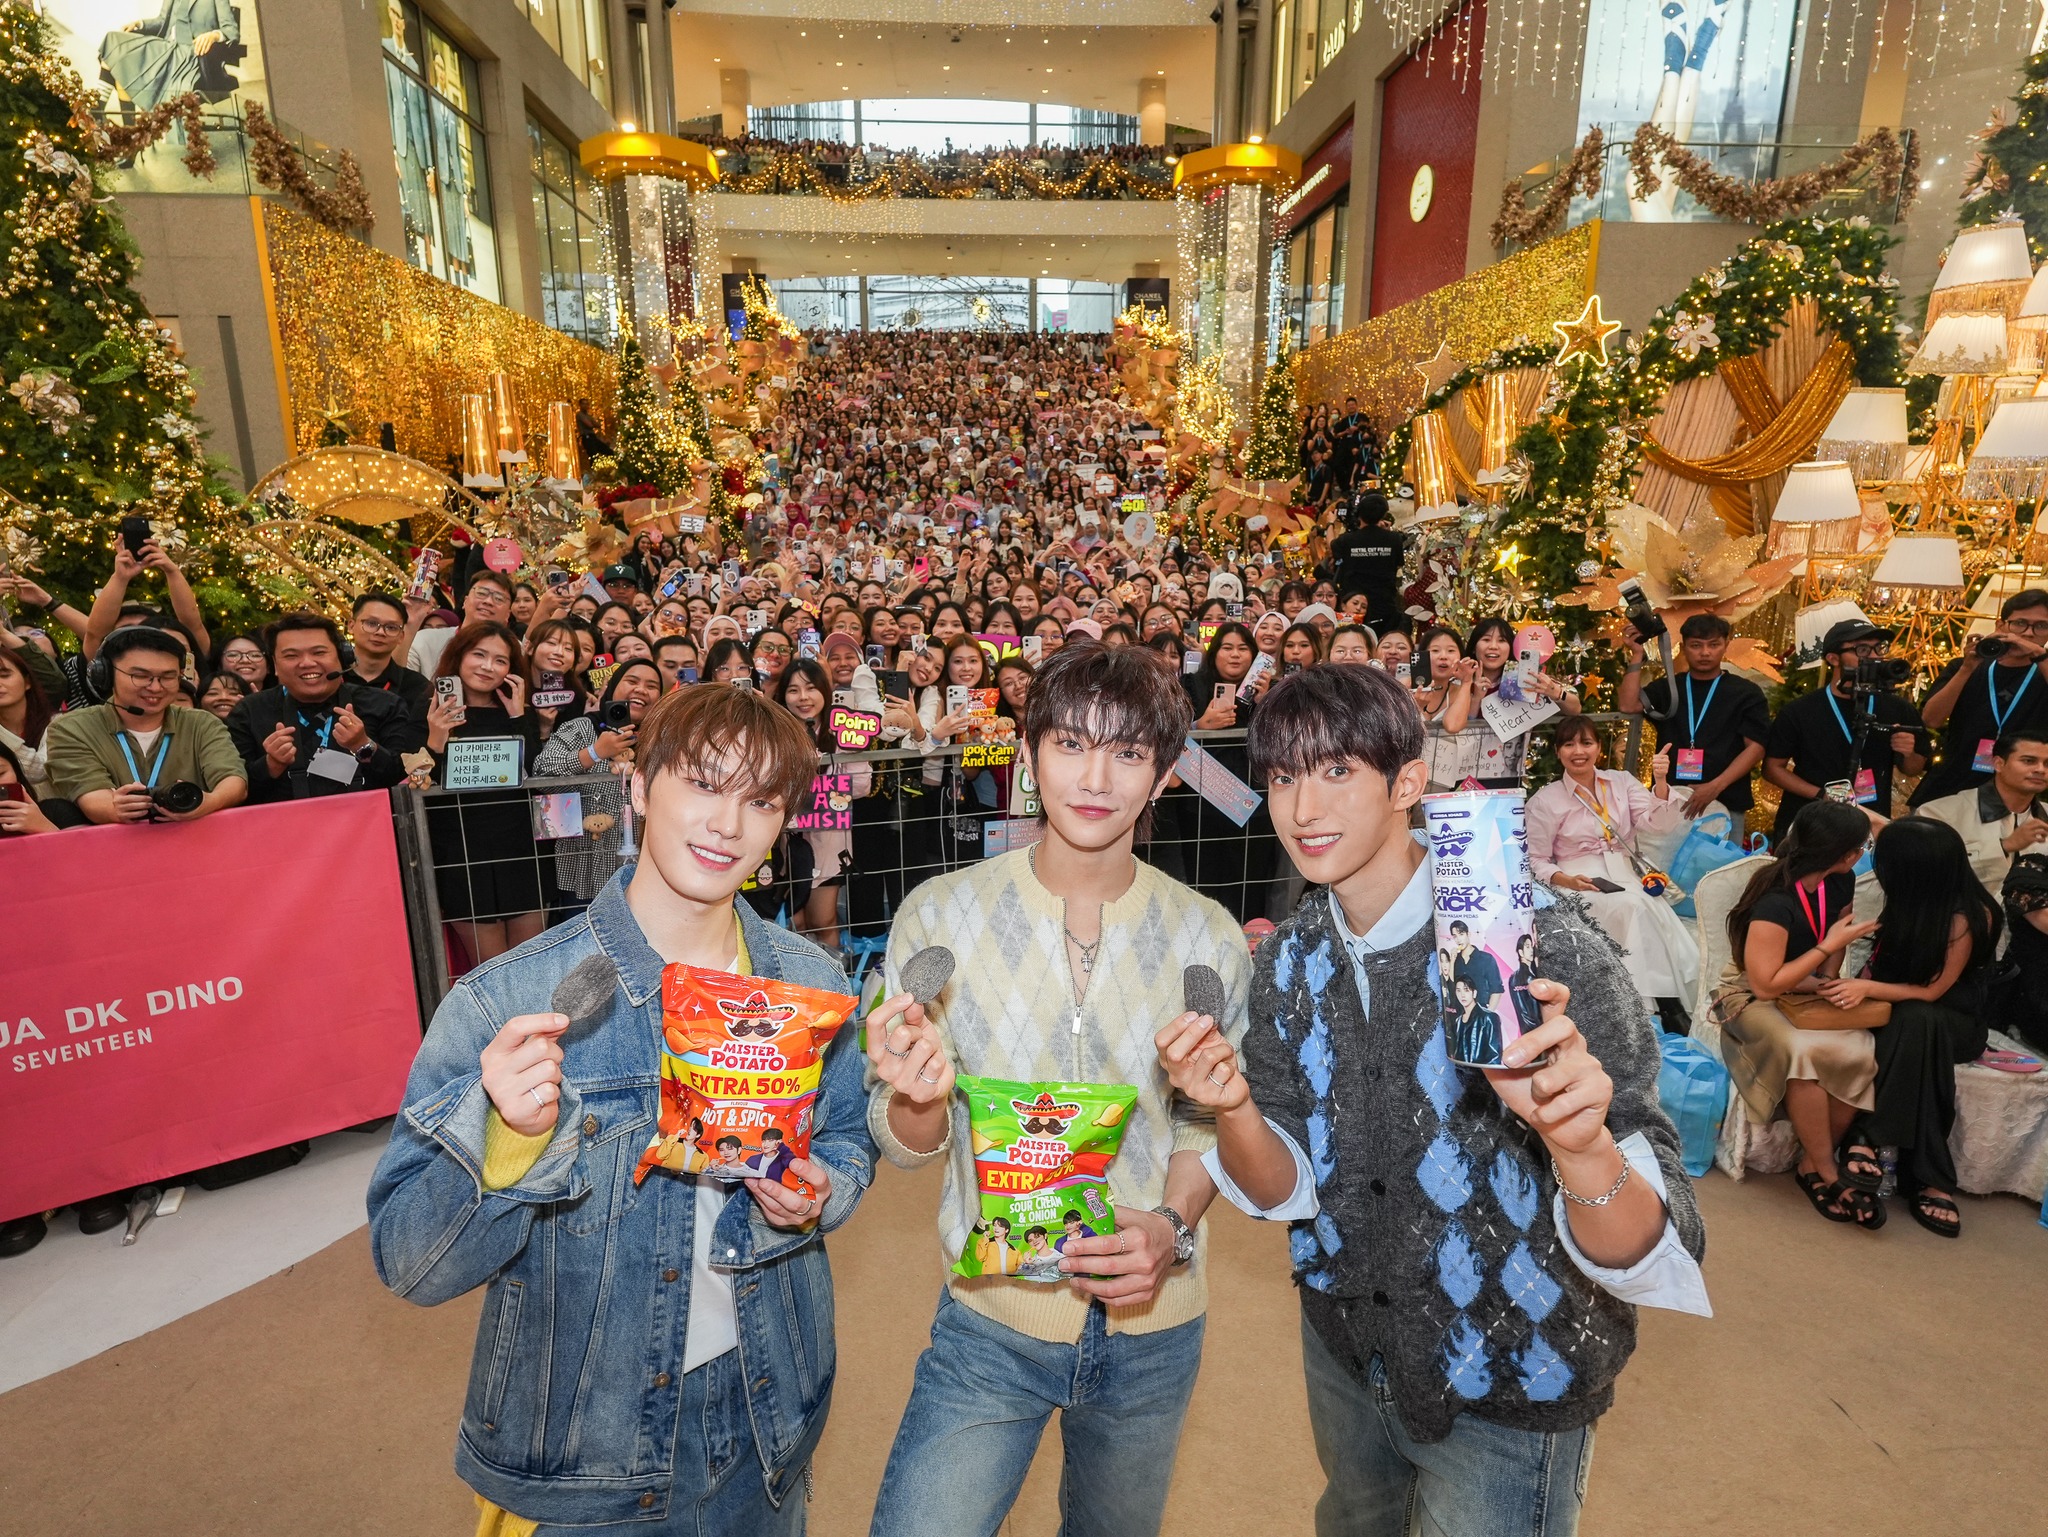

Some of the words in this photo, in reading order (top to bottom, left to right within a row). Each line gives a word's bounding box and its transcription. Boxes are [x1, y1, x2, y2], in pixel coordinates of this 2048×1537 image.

[801, 599, 821, 619] DK
[834, 712, 877, 732] Point
[1499, 707, 1532, 733] Heart
[841, 730, 866, 746] Me
[454, 744, 463, 753] 이
[466, 743, 502, 753] 카메라로
[963, 745, 987, 757] Look
[988, 744, 1015, 756] Cam
[453, 755, 490, 764] 여러분과
[492, 753, 511, 763] 함께
[961, 756, 985, 768] And
[986, 755, 1010, 766] Kiss
[453, 765, 480, 775] 사진을
[810, 775, 851, 793] AKE
[813, 793, 829, 810] A
[796, 811, 851, 829] WISH
[1436, 866, 1471, 876] POTATO
[1432, 885, 1487, 896] K-RAZY
[1434, 895, 1488, 911] KICK
[64, 998, 128, 1034] DK
[146, 976, 243, 1016] DINO
[12, 1027, 153, 1073] SEVENTEEN
[723, 1043, 776, 1057] MISTER
[711, 1050, 784, 1072] POTATO
[690, 1071, 750, 1095] EXTRA
[756, 1077, 801, 1095] 50%
[700, 1107, 724, 1126] HOT
[725, 1108, 738, 1127] &
[738, 1109, 776, 1128] SPICY
[1018, 1138, 1066, 1152] MISTER
[1008, 1147, 1072, 1166] POTATO
[987, 1169, 1043, 1190] EXTRA
[1009, 1199, 1033, 1214] SOUR
[1035, 1196, 1063, 1209] CREAM
[1018, 1213, 1026, 1223] &
[1028, 1208, 1057, 1222] ONION
